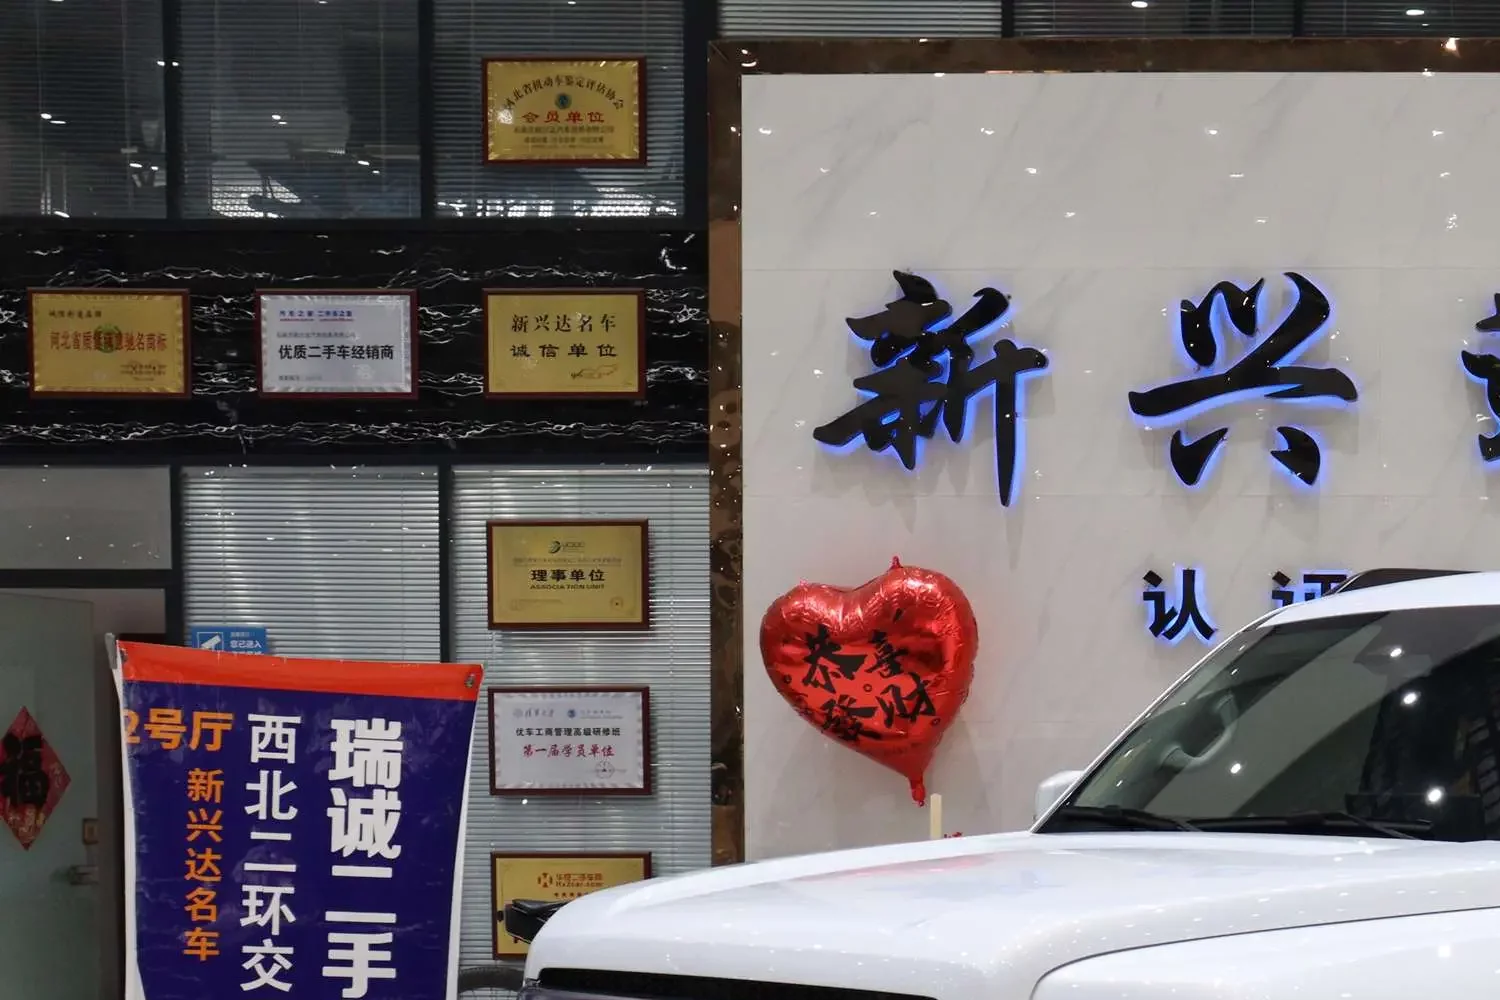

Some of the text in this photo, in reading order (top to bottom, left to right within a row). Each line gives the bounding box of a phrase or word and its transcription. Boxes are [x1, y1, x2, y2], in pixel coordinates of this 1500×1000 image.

[522, 111, 605, 124] 会员单位
[511, 313, 617, 333] 新兴达名车
[278, 345, 394, 360] 优质二手车经销商
[510, 344, 617, 358] 诚信单位
[530, 569, 605, 582] 理事单位
[123, 708, 234, 751] 2号厅
[523, 744, 615, 758] 第一届学员单位
[183, 767, 225, 961] 新兴达名车
